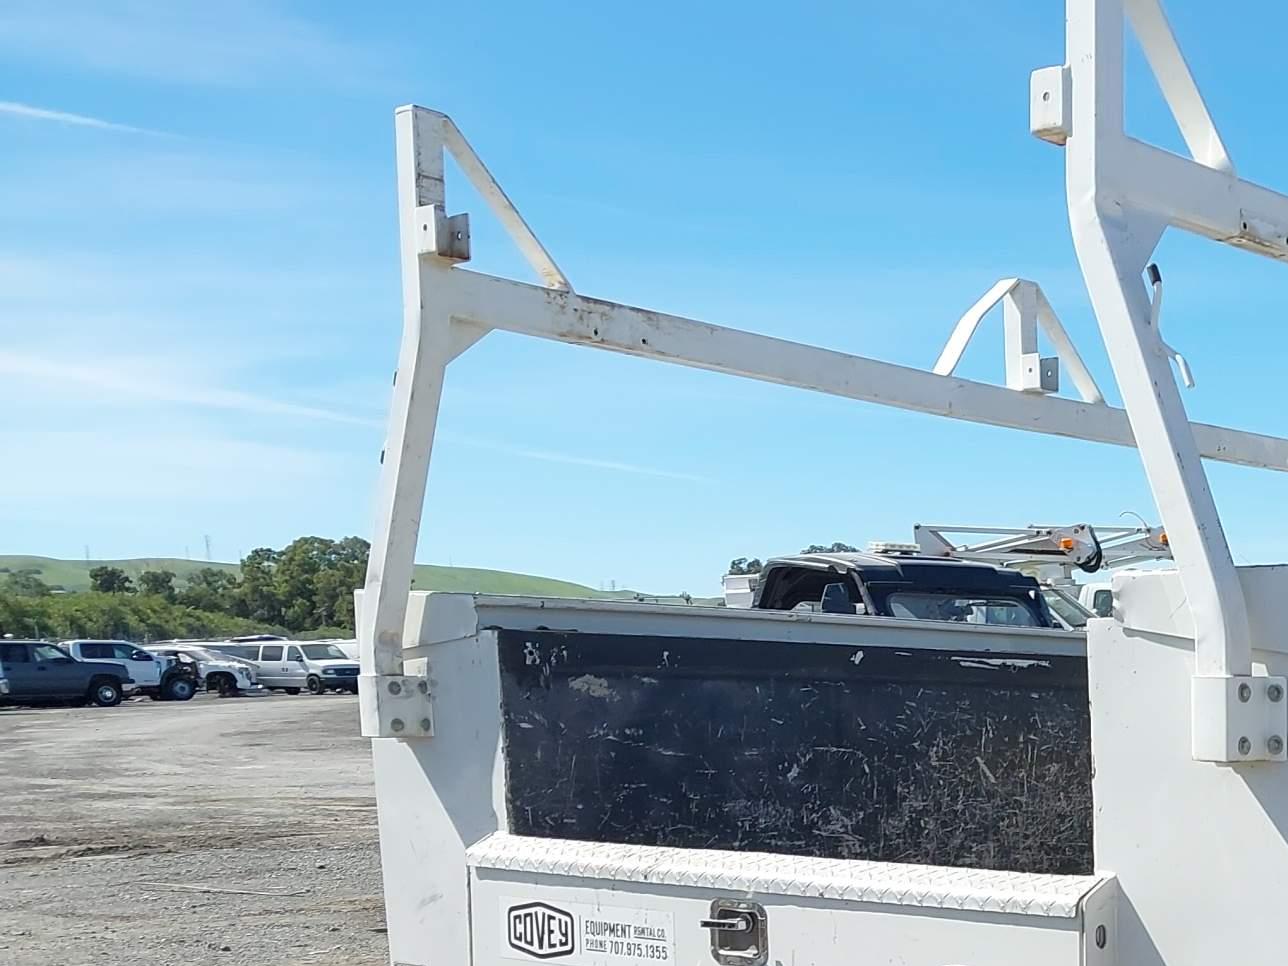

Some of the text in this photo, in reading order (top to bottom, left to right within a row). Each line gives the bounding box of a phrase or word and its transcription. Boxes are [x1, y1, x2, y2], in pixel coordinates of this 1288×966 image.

[512, 910, 569, 950] COVEY
[585, 920, 632, 938] EQUIPMENT
[585, 938, 668, 960] PHONE 707.975.1355
